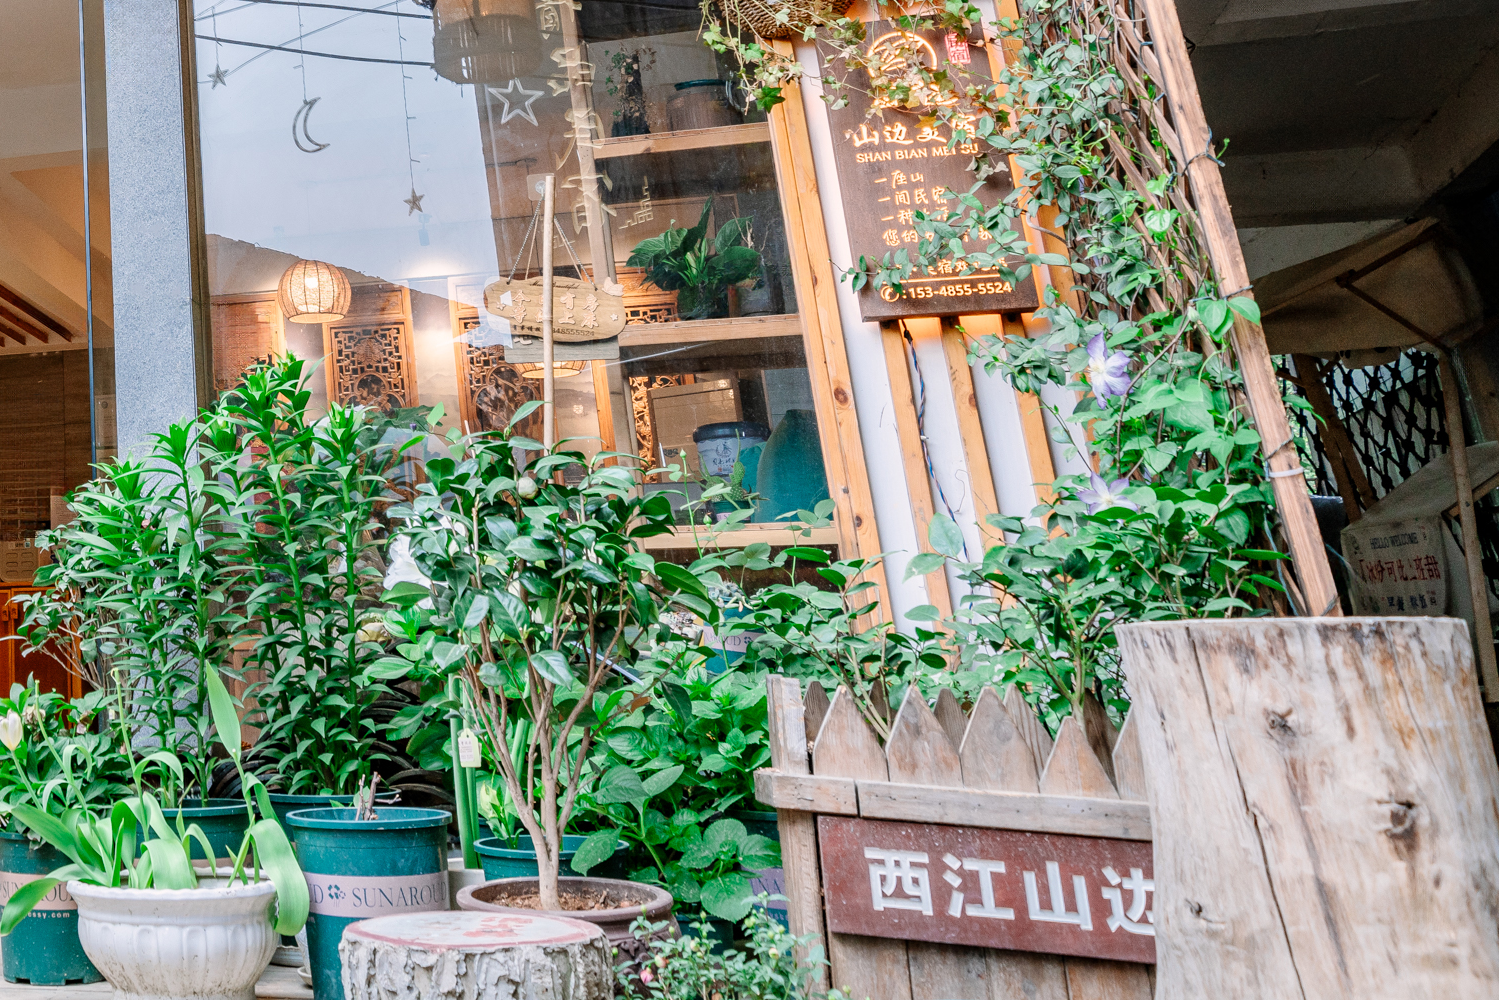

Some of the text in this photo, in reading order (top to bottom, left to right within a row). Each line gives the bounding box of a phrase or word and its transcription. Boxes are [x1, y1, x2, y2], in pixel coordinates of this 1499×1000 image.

[856, 151, 891, 164] SHAN
[895, 148, 927, 161] BIAN
[874, 169, 924, 189] 一座山
[352, 881, 447, 908] SUNAROUD
[864, 847, 1156, 936] 西江山边
